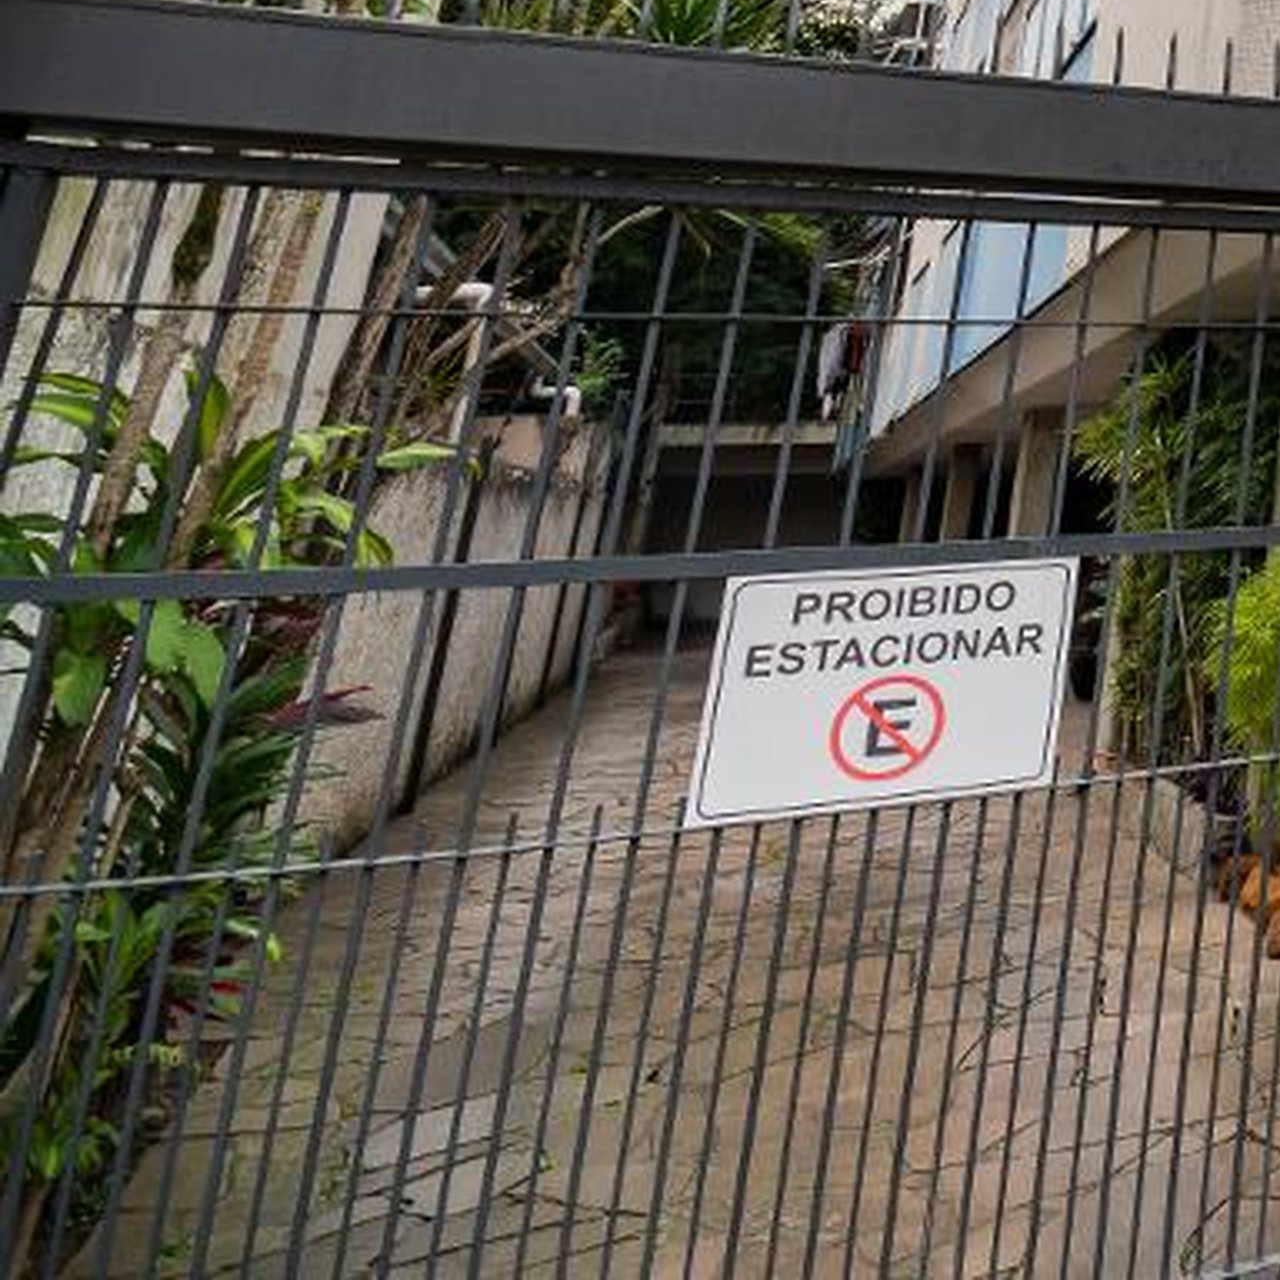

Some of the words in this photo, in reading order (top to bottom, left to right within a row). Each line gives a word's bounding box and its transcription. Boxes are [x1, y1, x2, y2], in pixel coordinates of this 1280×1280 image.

[792, 581, 1016, 626] PROIBIDO
[745, 623, 1044, 678] ESTACIONAR
[865, 697, 917, 757] E
